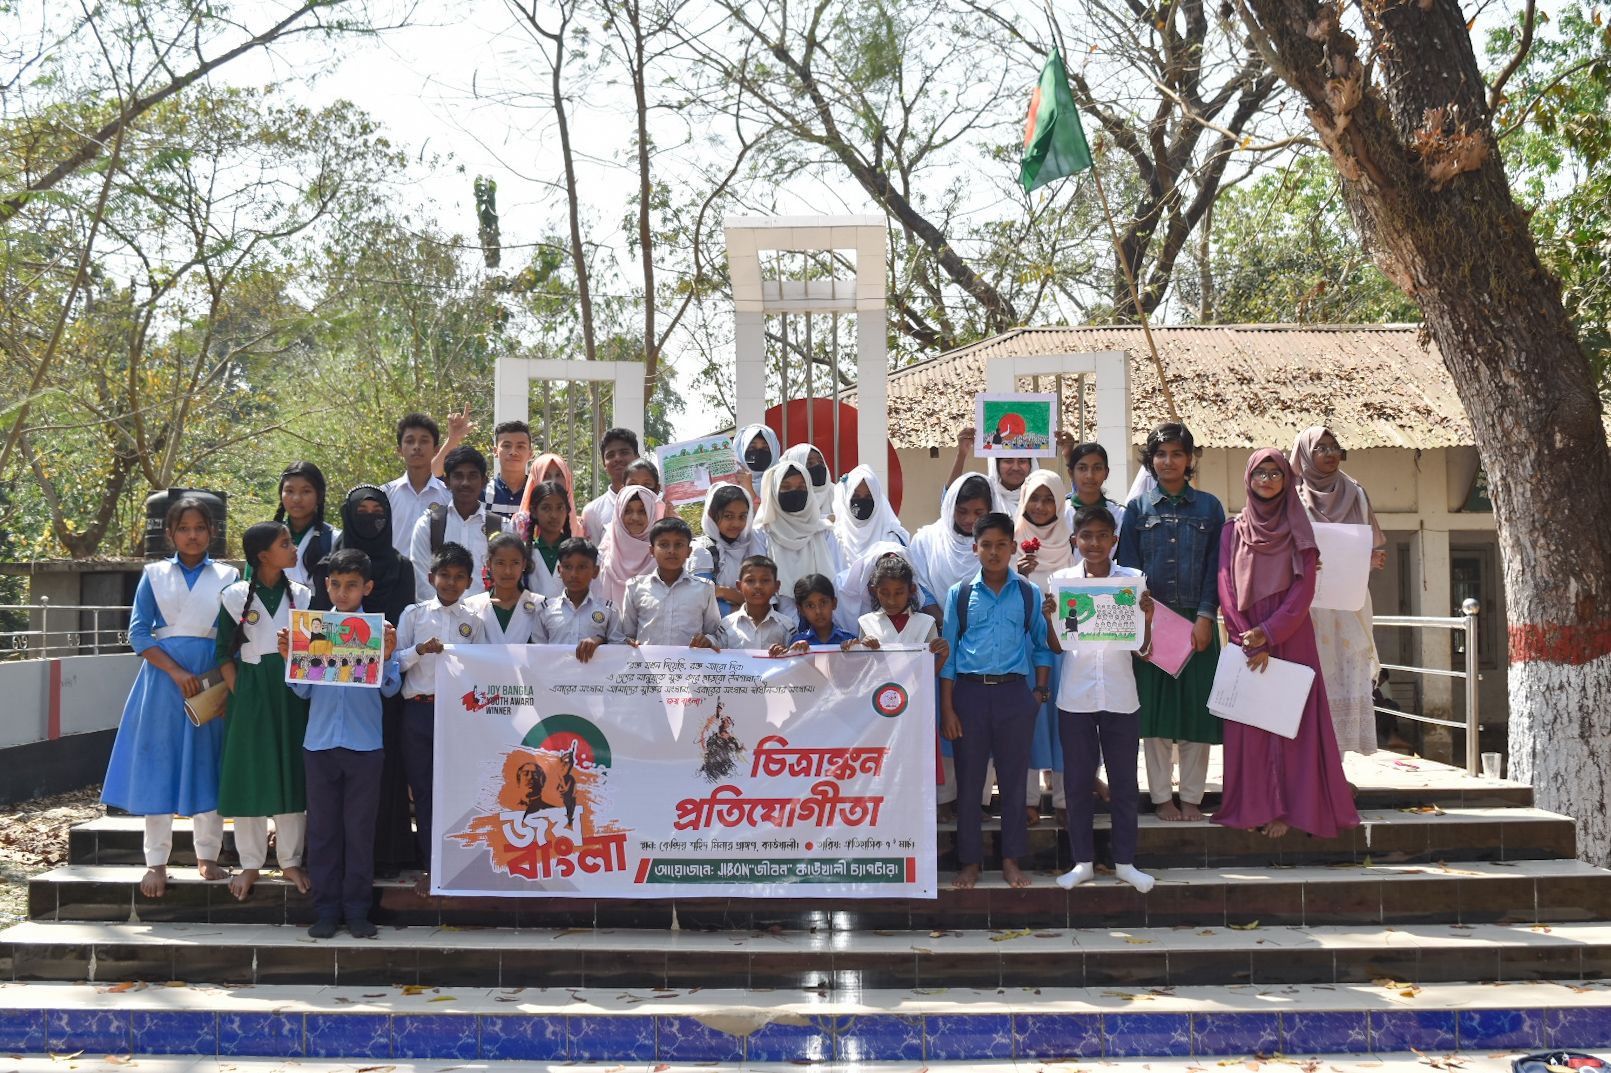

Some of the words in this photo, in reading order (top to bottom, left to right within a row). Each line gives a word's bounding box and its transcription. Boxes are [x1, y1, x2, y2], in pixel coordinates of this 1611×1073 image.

[606, 673, 614, 681] এ
[487, 685, 501, 696] JOY
[502, 685, 534, 696] BANGLA
[549, 684, 577, 696] এবারের
[579, 684, 604, 694] সংগ্রাম
[606, 685, 638, 696] আমাদের
[693, 685, 721, 697] এবারের
[723, 686, 748, 694] সংগ্রাম
[486, 696, 509, 706] YOUTH
[510, 697, 534, 707] AWARD
[486, 706, 512, 716] WINNER
[750, 734, 890, 781] চিত্রাঙ্কন
[673, 780, 885, 831] প্রতিযোগীতা
[504, 834, 628, 880] বাংলা
[795, 859, 847, 877] কাউখালী
